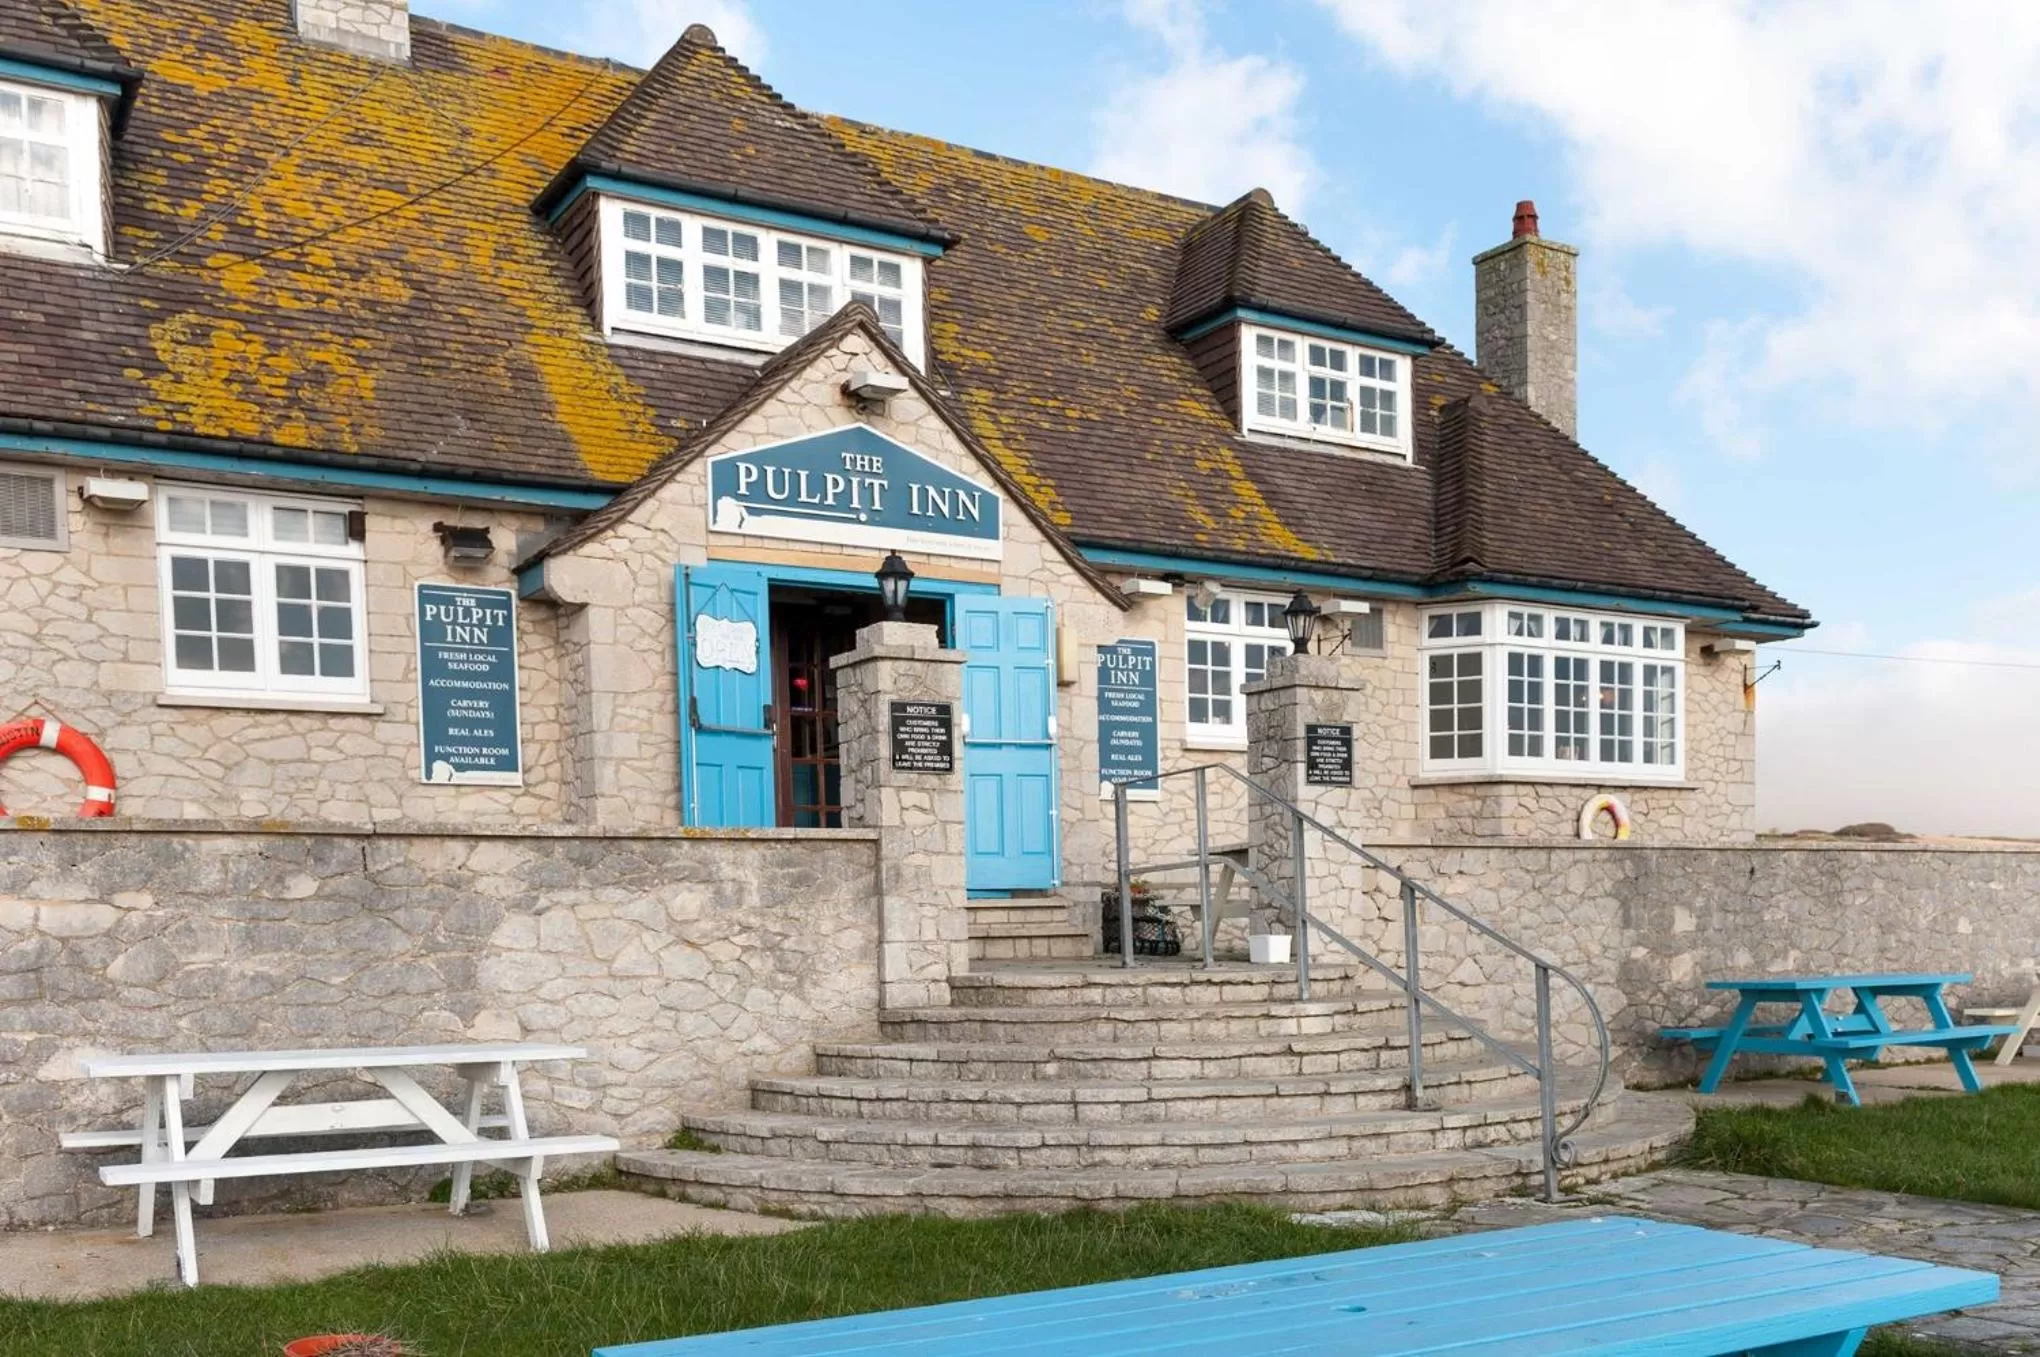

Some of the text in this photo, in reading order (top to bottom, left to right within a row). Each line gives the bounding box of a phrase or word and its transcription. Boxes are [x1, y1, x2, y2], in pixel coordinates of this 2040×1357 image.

[841, 451, 883, 474] THE
[735, 461, 982, 523] PULPIT INN
[455, 597, 476, 606] THE
[424, 604, 508, 626] PULPIT
[446, 624, 489, 644] INN
[1117, 646, 1132, 654] THE
[438, 651, 498, 663] FRESH LOCAL
[1097, 653, 1152, 670] PULPIT
[448, 662, 490, 672] SEAFOOD
[1110, 670, 1140, 684] INN
[428, 678, 510, 691] ACCOMMODATION
[450, 698, 490, 708] CARVERY
[446, 708, 496, 720] (SUNDAYS)
[906, 706, 937, 714] NOTICE
[448, 727, 495, 737] REAL ALES
[434, 744, 510, 756] FUNCTION ROOM
[448, 756, 496, 766] AVAILABLE
